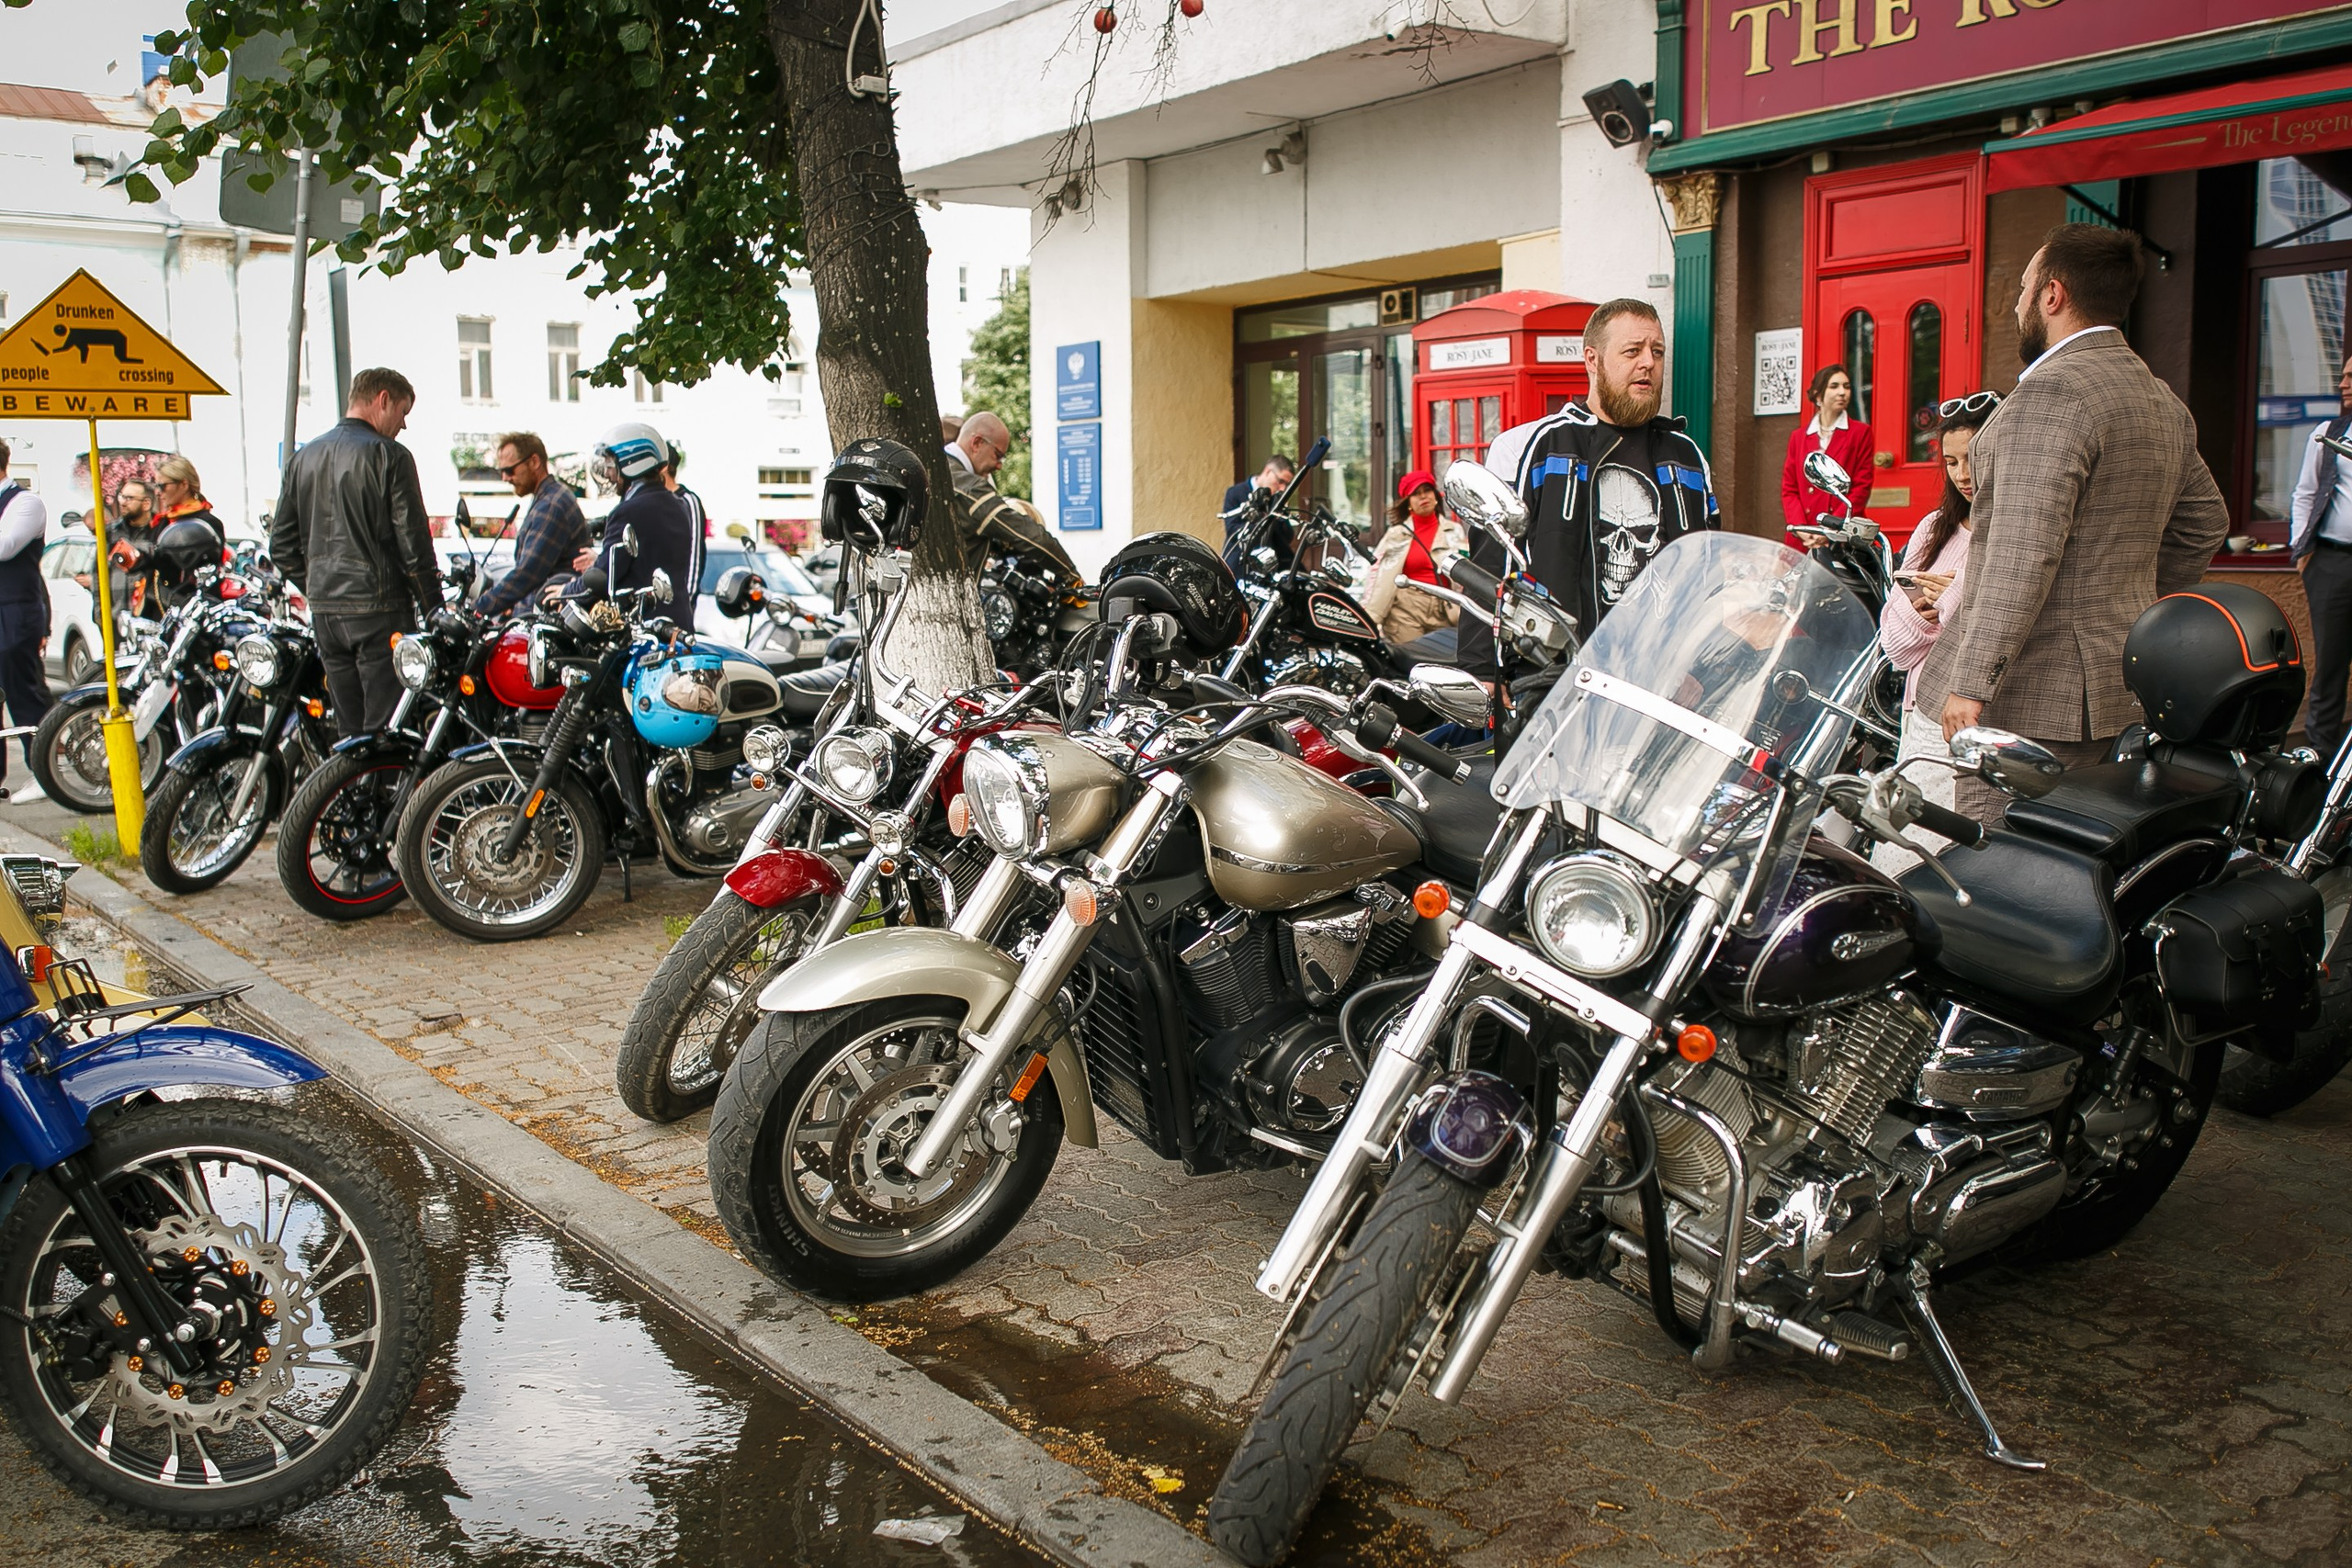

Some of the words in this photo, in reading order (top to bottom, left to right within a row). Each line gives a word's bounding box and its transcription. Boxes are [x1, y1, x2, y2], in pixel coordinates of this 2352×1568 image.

[1729, 0, 1920, 77] THE
[2217, 120, 2263, 149] The
[2270, 114, 2352, 146] Legen
[55, 303, 115, 321] Drunken
[1446, 351, 1468, 363] ROSY
[1555, 344, 1578, 356] ROSY
[1, 366, 51, 383] people
[119, 368, 175, 385] crossing
[2, 395, 179, 413] BEWARE
